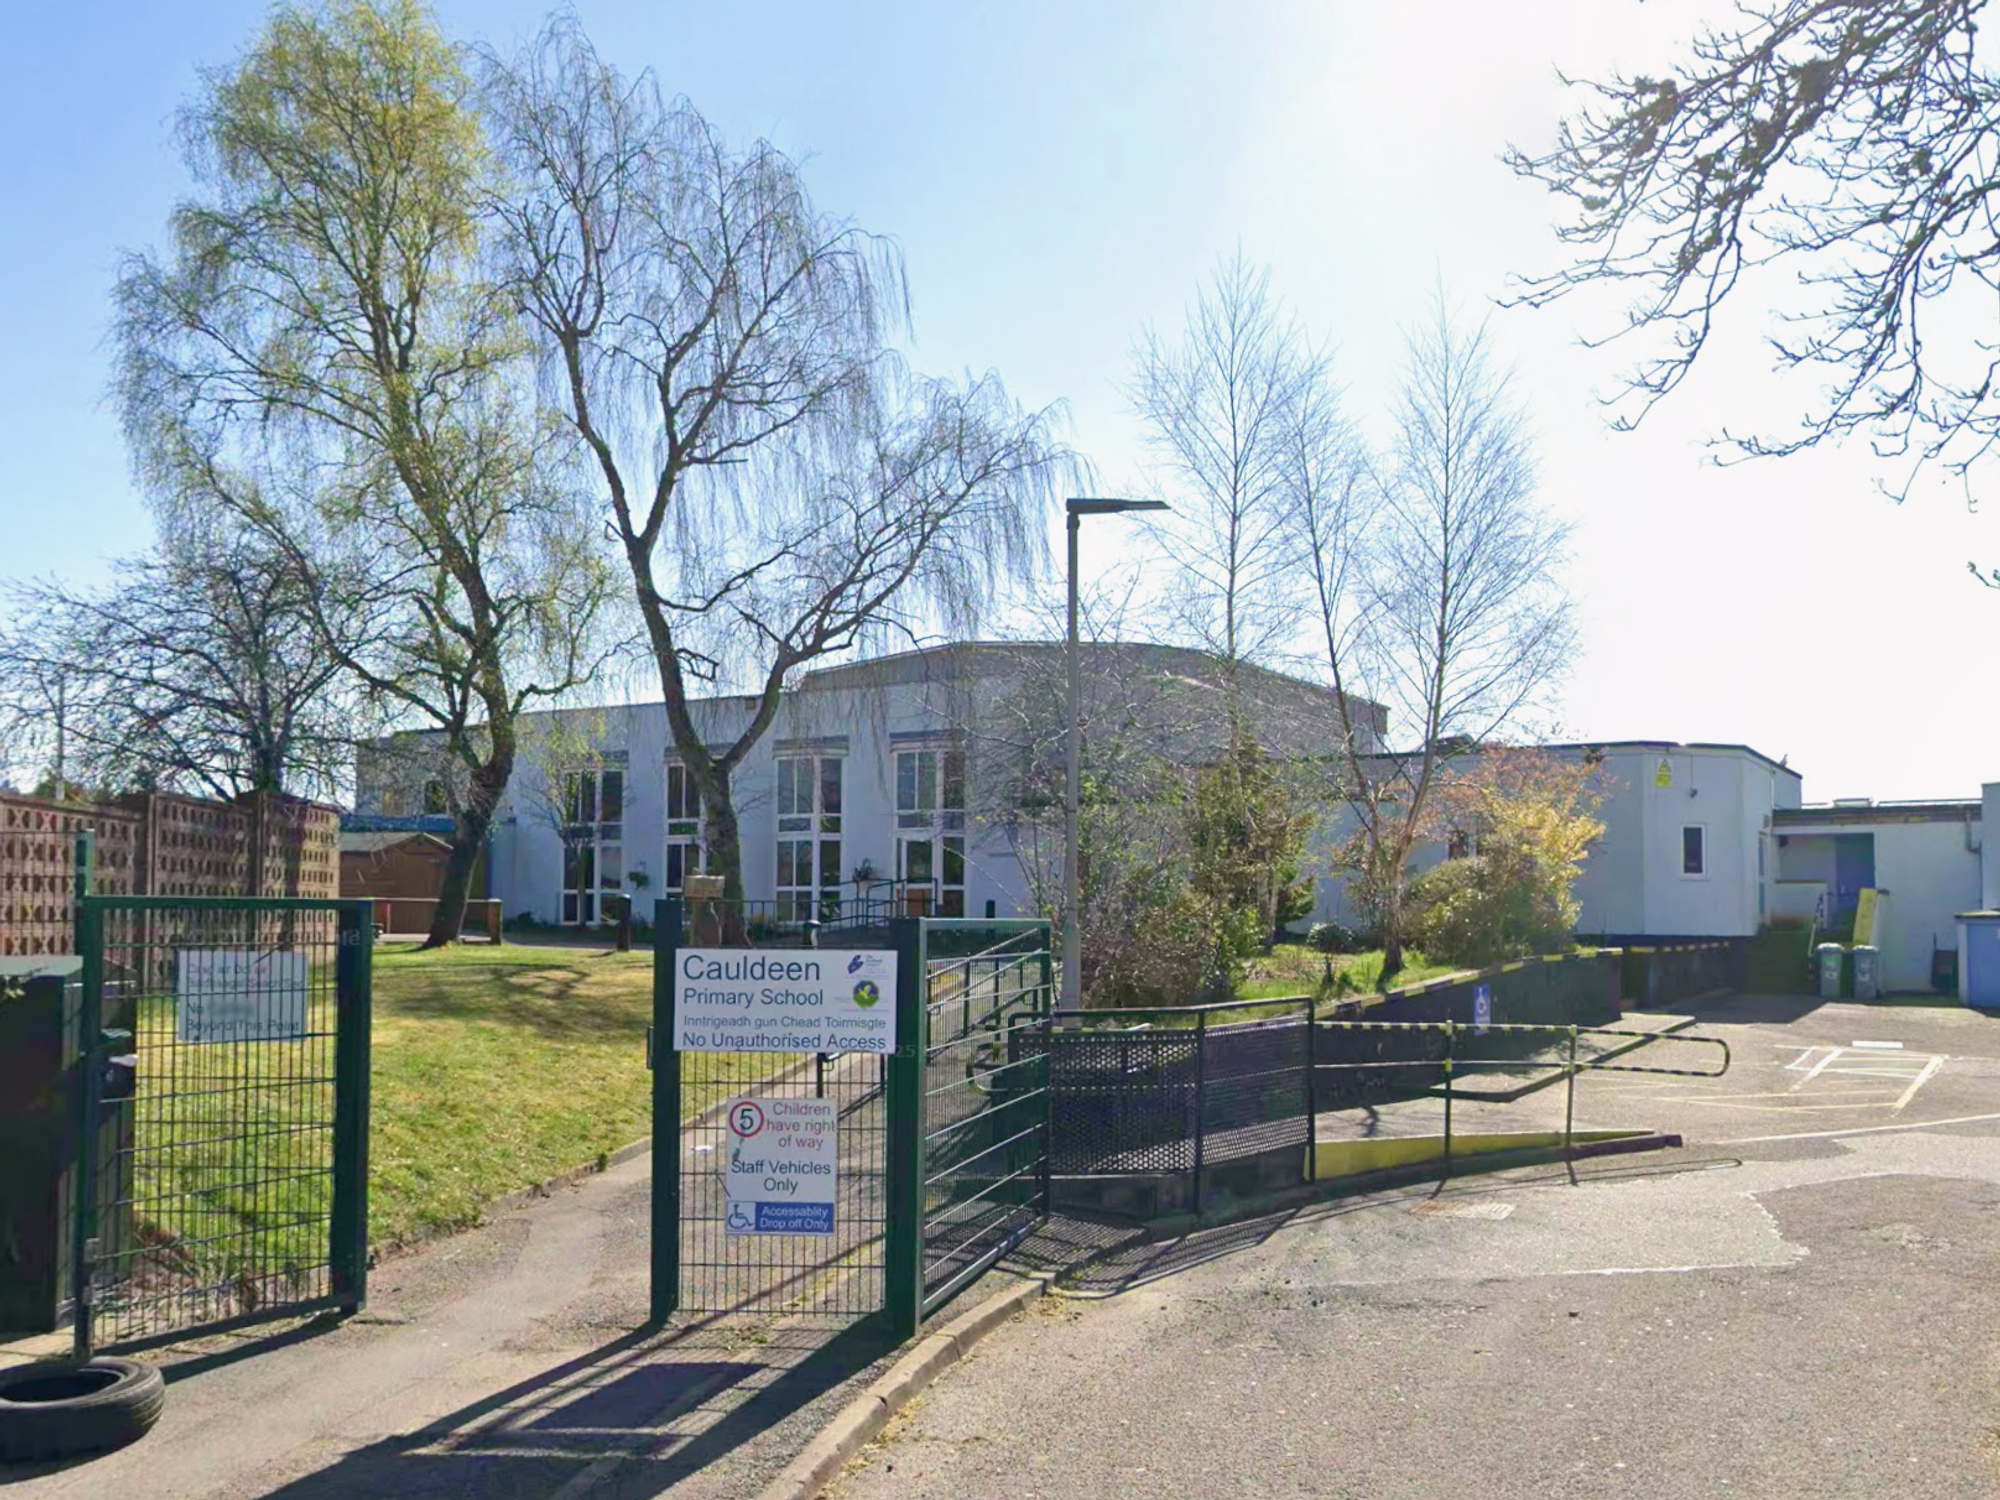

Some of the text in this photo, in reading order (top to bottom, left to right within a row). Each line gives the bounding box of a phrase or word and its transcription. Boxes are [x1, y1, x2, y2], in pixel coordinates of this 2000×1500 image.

[683, 954, 820, 981] Cauldeen
[683, 987, 824, 1009] Primary School
[268, 1018, 300, 1031] Point
[684, 1015, 887, 1031] Inntrigeadh gun Chead Toirmisgte
[682, 1032, 887, 1050] No Unauthorised Access
[773, 1102, 831, 1116] Children
[739, 1108, 754, 1131] 5
[766, 1119, 836, 1135] have right
[778, 1135, 824, 1151] of way
[731, 1159, 832, 1175] Staff Vehicles
[763, 1177, 799, 1195] Only
[760, 1217, 829, 1231] Drop off Only
